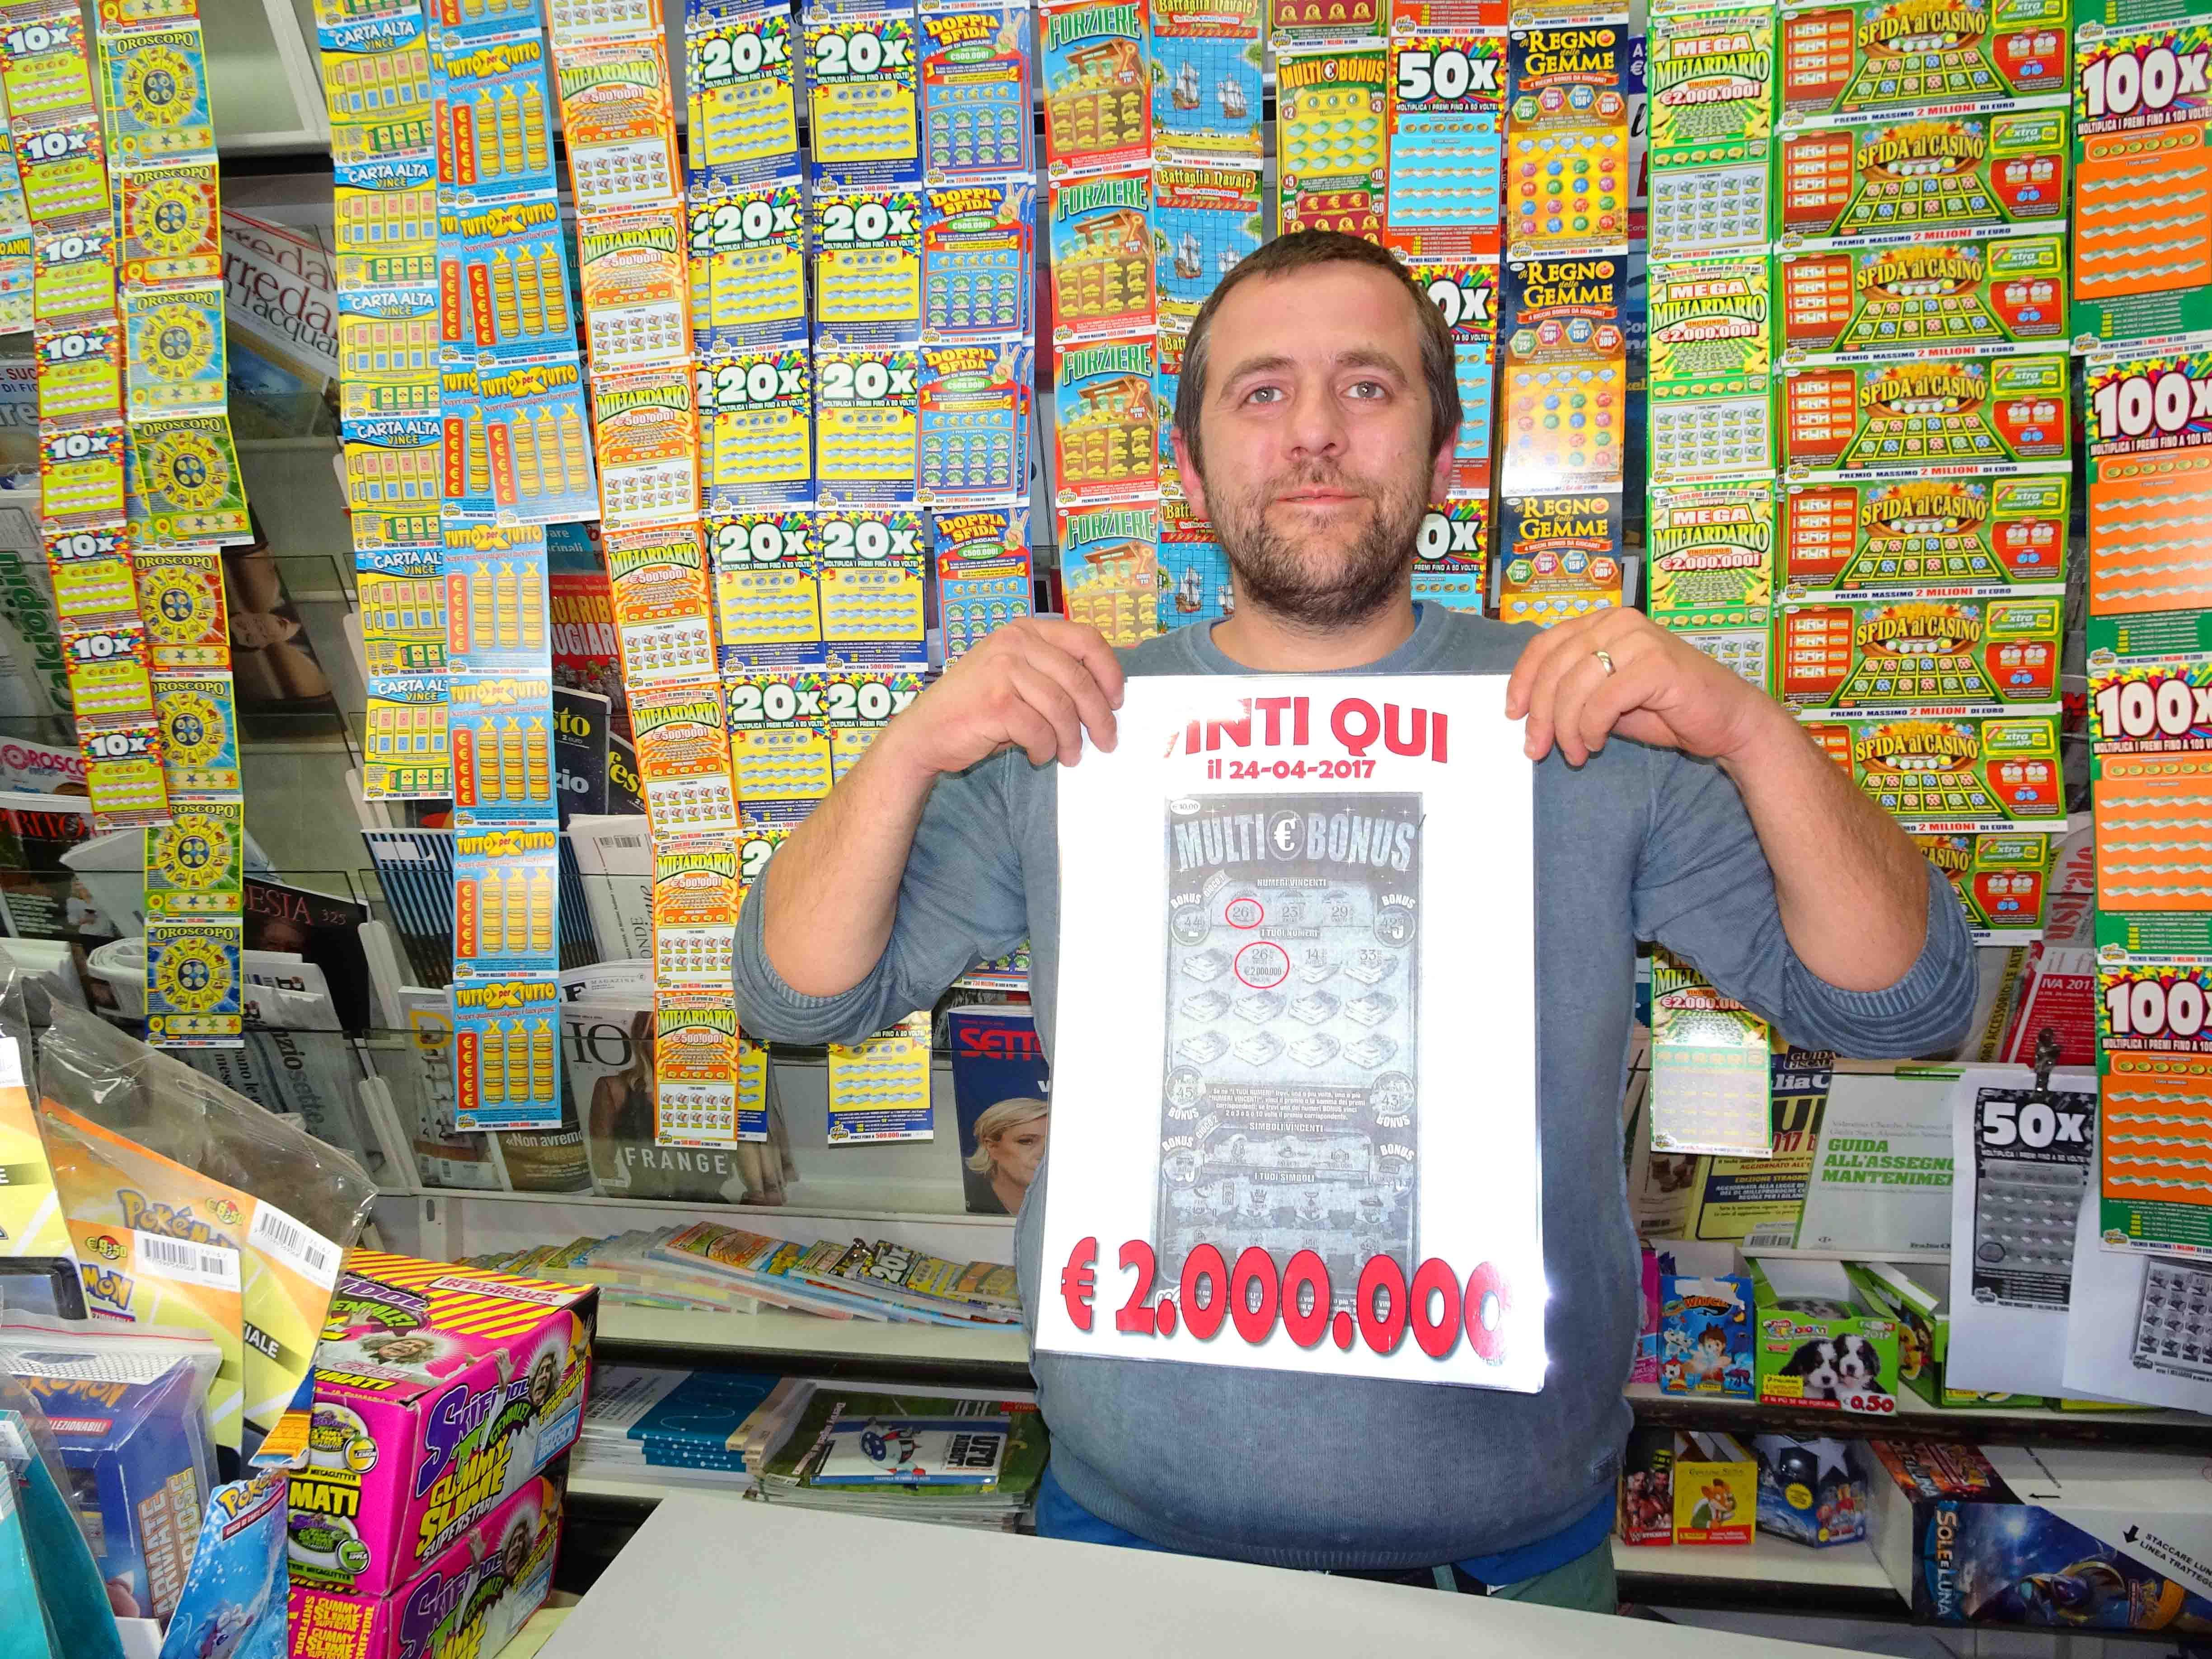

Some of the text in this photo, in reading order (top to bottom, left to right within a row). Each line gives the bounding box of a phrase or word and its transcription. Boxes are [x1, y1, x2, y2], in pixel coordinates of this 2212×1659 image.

[333, 21, 416, 48] CARTA ALTA
[927, 14, 999, 37] DOPPIA
[940, 28, 991, 45] SFIDA
[1048, 13, 1140, 51] FORZIERE
[6, 25, 70, 54] 10x
[116, 32, 194, 55] OROSCOPO
[364, 37, 395, 50] VINCE
[1528, 31, 1616, 49] REGNO
[1673, 38, 1751, 56] MEGA
[447, 43, 540, 80] TUTTO per TUTTO
[701, 31, 787, 80] 20x
[1526, 51, 1614, 74] GEMME
[817, 75, 847, 84] MOLTIPLICA
[850, 74, 867, 83] PREMI
[892, 71, 910, 80] VOLTE!
[1280, 59, 1385, 89] MULTI BONUS
[1397, 51, 1498, 100] 50x
[2081, 47, 2210, 117] 100x
[1834, 116, 1867, 124] PREMIO
[1871, 111, 1915, 120] MASSIMO
[1917, 108, 1924, 117] 2
[1928, 103, 1976, 115] MILIONI
[2077, 120, 2118, 136] MOLTIPLICA
[2124, 117, 2144, 131] PREMI
[2146, 115, 2163, 127] FINO
[2173, 111, 2187, 124] 100
[1856, 137, 1909, 171] SFIDA
[1912, 140, 1926, 157] al
[132, 166, 211, 187] OROSCOPO
[1159, 169, 1252, 189] Battaglia Navale
[712, 200, 798, 243] 20x
[821, 200, 916, 242] 20x
[46, 236, 105, 262] 10x
[136, 291, 217, 312] OROSCOPO
[47, 334, 105, 361] 10x
[1062, 345, 1152, 386] FORZIERE
[357, 421, 441, 439] CARTA ALTA
[386, 435, 419, 445] VINCE
[1673, 507, 1750, 525] MEGA
[718, 520, 809, 561] 20x
[1067, 509, 1157, 549] FORZIERE
[56, 533, 116, 559] 10x
[135, 556, 213, 572] OROSCOPO
[730, 682, 823, 723] 20x
[1331, 698, 1448, 764] QUI
[90, 734, 149, 757] 10x
[1855, 734, 1906, 763] SFIDA
[1910, 735, 1922, 752] al
[1208, 759, 1376, 779] il 24-04-2017
[1175, 813, 1265, 868] MULTI
[1307, 813, 1415, 871] BONUS
[1171, 894, 1201, 909] BONUS
[1382, 895, 1416, 909] BONUS
[156, 927, 234, 942] OROSCOPO
[2042, 978, 2063, 989] IVA
[456, 983, 557, 1008] TUTTO per TUTTO
[1168, 1107, 1199, 1121] BONUS
[1377, 1115, 1410, 1128] BONUS
[1982, 1101, 2086, 1148] 50x
[1250, 1122, 1324, 1133] SIMBOLI VINCENTI
[1162, 1135, 1194, 1151] BONUS
[1380, 1143, 1415, 1161] BONUS
[1829, 1139, 1889, 1152] GUIDA
[1280, 1173, 1316, 1182] SIMBOLI
[422, 1499, 492, 1563] SUPERSTAR
[2140, 1541, 2166, 1561] LINEA
[2146, 1533, 2193, 1564] STACCARE
